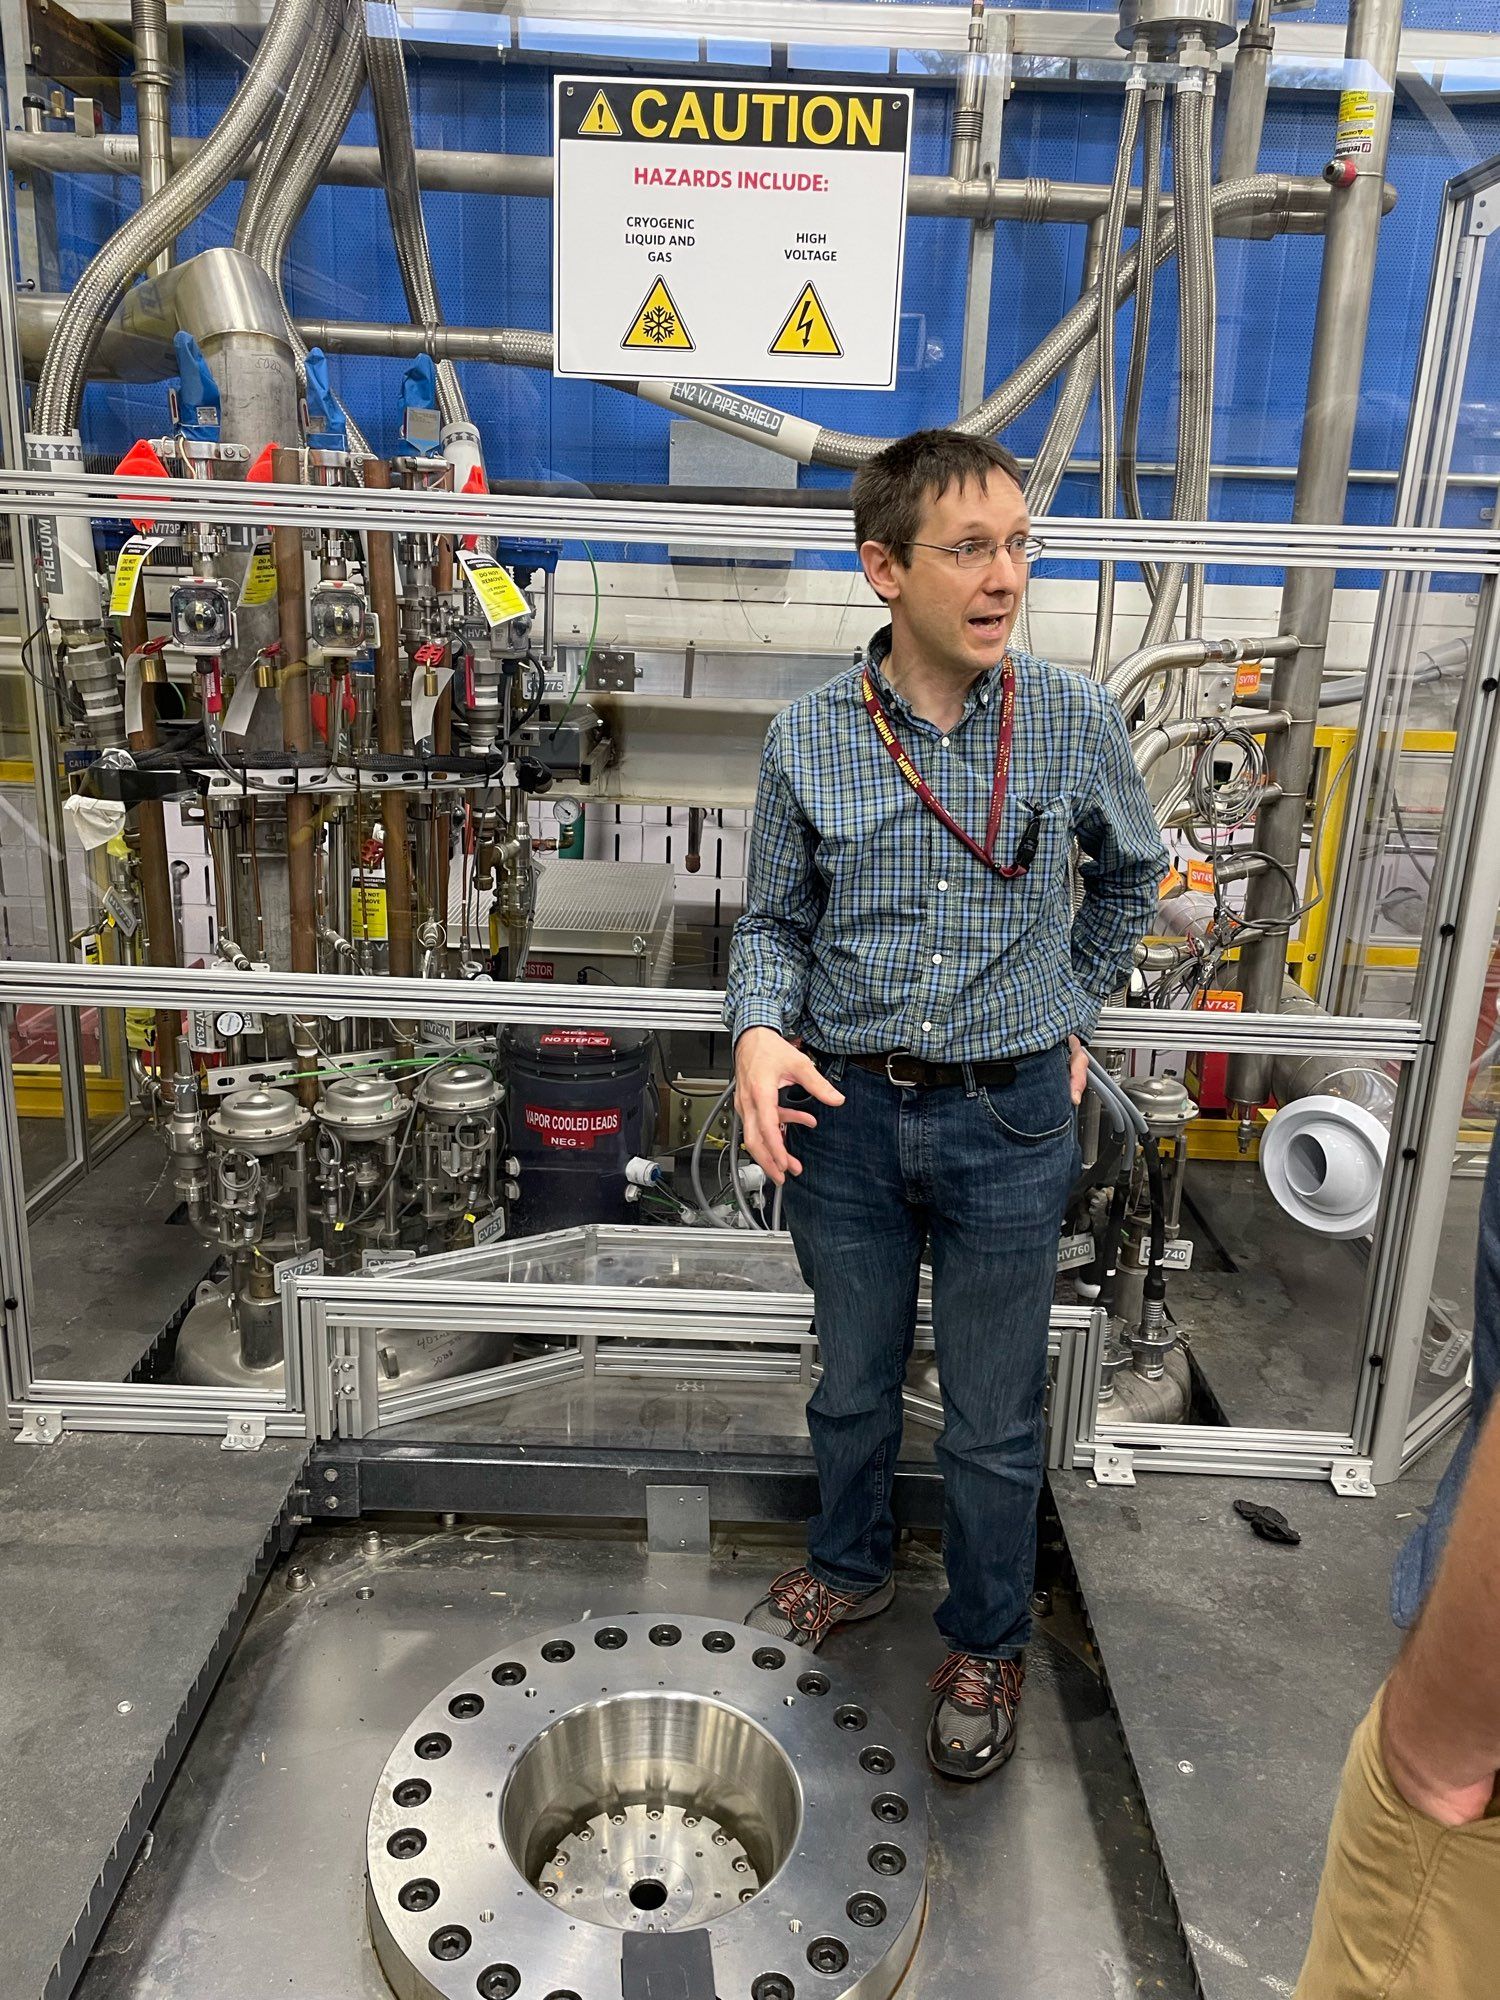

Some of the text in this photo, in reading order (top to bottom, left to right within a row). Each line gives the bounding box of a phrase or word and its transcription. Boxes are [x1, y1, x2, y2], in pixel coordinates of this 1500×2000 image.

[630, 88, 883, 147] CAUTION
[633, 166, 830, 193] HAZARDS INCLUDE:
[625, 215, 696, 230] CRYOGENIC
[624, 233, 696, 248] LIQUID AND
[795, 232, 827, 245] HIGH
[647, 251, 672, 264] GAS
[783, 249, 838, 263] VOLTAGE
[698, 388, 712, 407] VJ
[712, 393, 740, 416] PIPE
[740, 404, 781, 430] SHIELD
[38, 518, 56, 583] HELIUM
[527, 681, 563, 691] C775
[872, 709, 895, 746] NHMFL
[896, 752, 922, 789] NHMFL
[195, 1010, 206, 1047] V753A
[563, 1036, 588, 1044] STEP
[525, 1109, 618, 1131] VAPOR COOLED LEADS
[550, 1136, 577, 1146] NEG
[1056, 1243, 1090, 1261] HV760
[1145, 1248, 1186, 1260] C740
